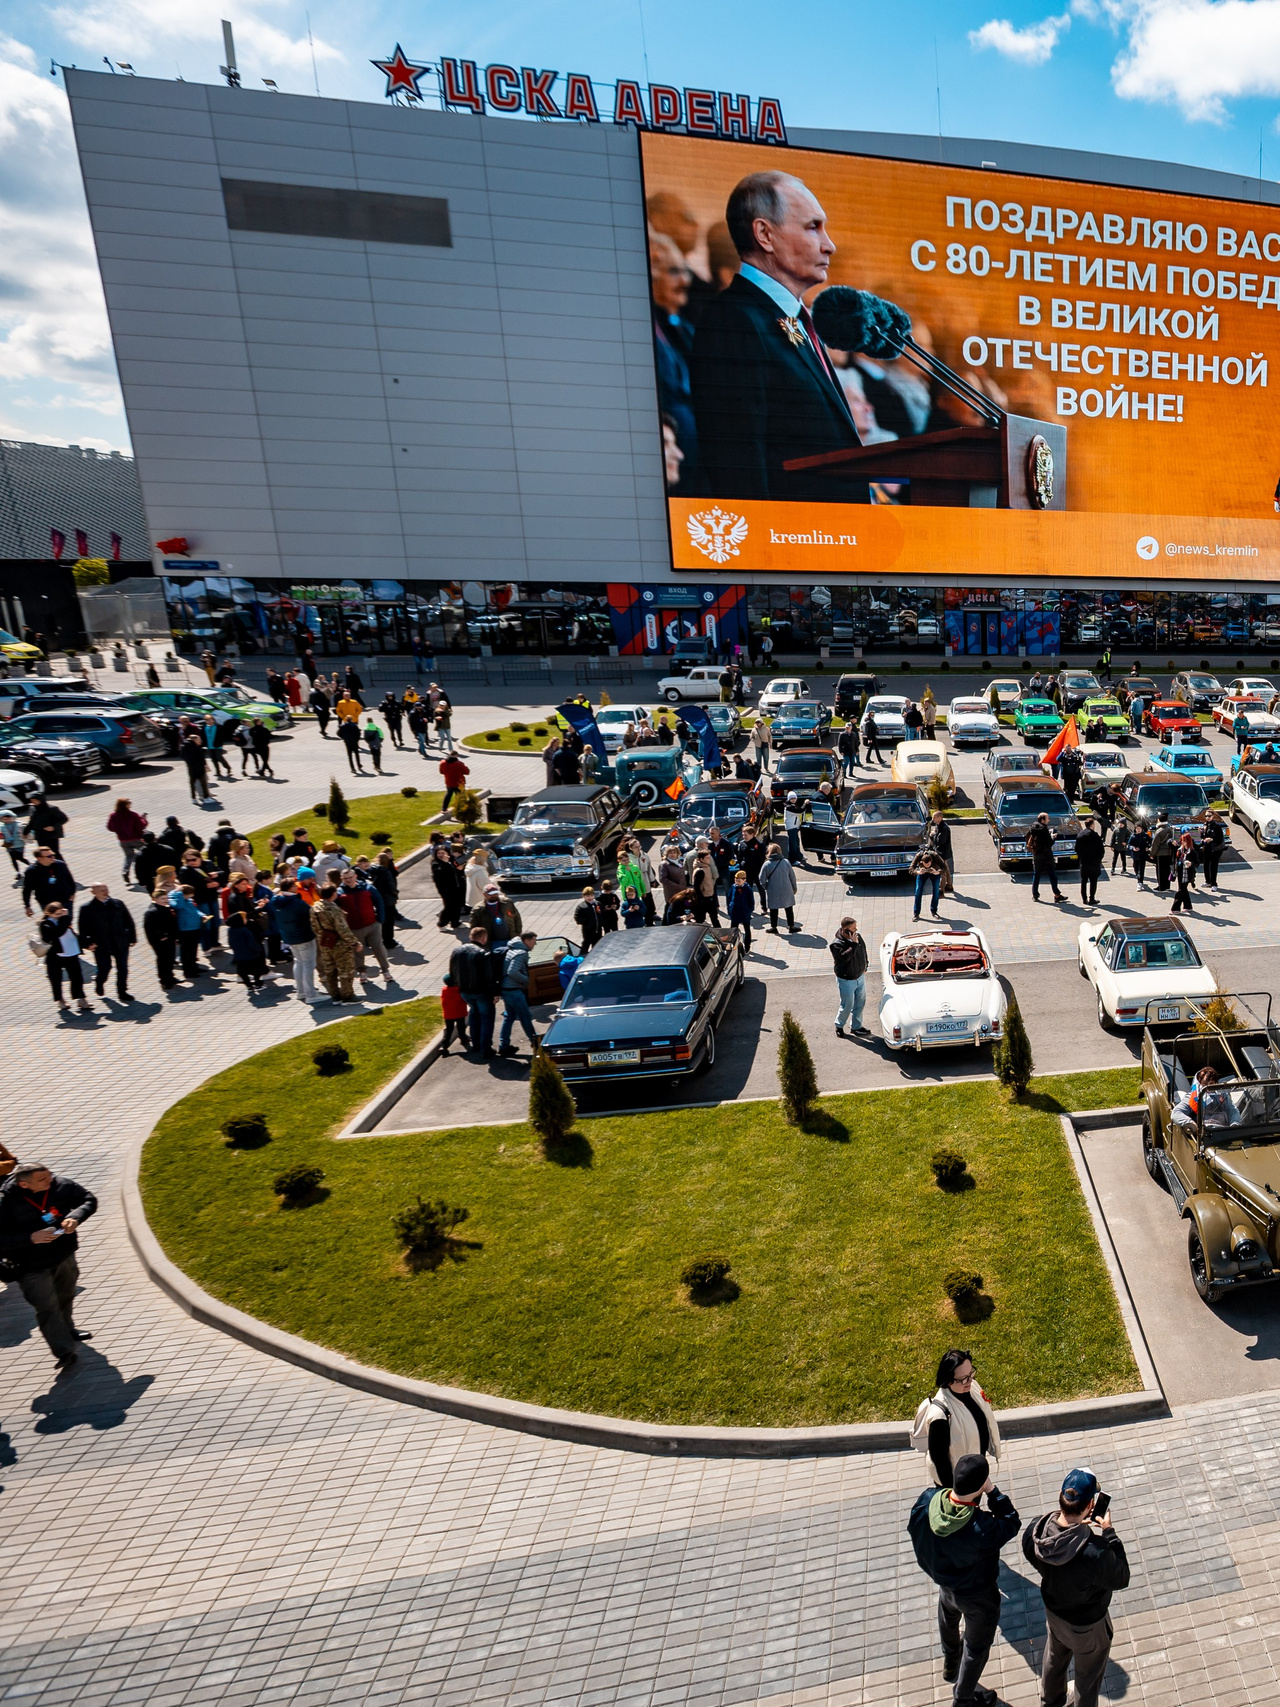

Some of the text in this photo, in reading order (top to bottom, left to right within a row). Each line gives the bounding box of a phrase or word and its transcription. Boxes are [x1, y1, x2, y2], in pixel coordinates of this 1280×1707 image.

[440, 56, 788, 145] ЦСКА АРЕНА
[946, 196, 1208, 253] ПОЗДРАВЛЯЮ
[910, 240, 936, 271] С
[946, 243, 1157, 293] 80-ЛЕТИЕМ
[1018, 295, 1220, 341] В ВЕЛИКОЙ
[962, 335, 1268, 387] ОТЕЧЕСТВЕННОЙ
[1056, 383, 1184, 423] ВОЙНЕ!
[769, 529, 858, 546] kremlin.ru
[1165, 542, 1259, 557] @news_kremlin
[968, 593, 996, 603] ЦСКА
